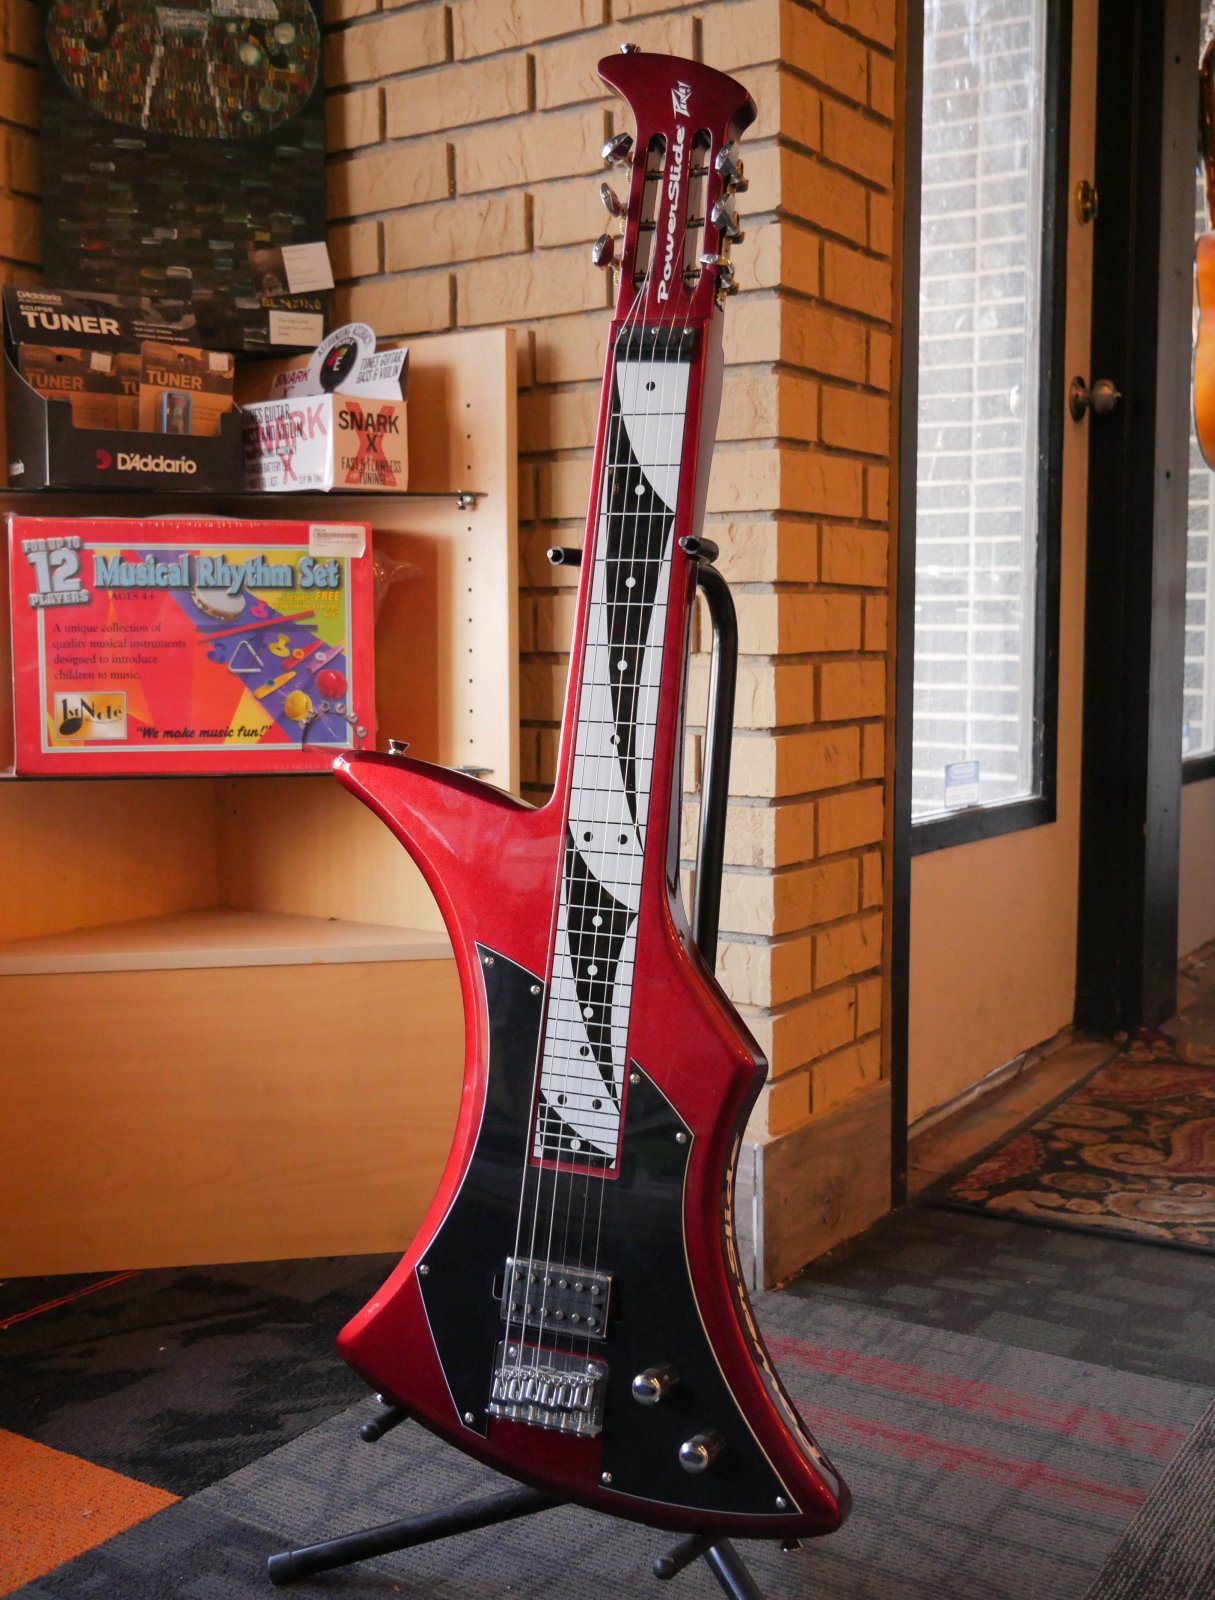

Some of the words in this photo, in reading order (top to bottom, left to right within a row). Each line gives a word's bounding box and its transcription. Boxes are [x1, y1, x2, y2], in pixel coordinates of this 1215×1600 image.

[657, 125, 686, 303] PowerSlide
[21, 311, 121, 336] TUNER
[25, 373, 84, 391] TUNER
[147, 370, 203, 390] TUNER
[264, 404, 290, 423] GUITAR
[338, 410, 400, 434] SNARK
[366, 433, 378, 453] X
[117, 453, 197, 474] D'Addario
[341, 457, 359, 471] FAST
[367, 458, 402, 474] FLAWLESS
[21, 539, 46, 553] FOR
[47, 537, 63, 550] UP
[63, 535, 82, 549] TO
[27, 548, 82, 594] 12
[93, 553, 191, 589] Musical
[196, 553, 294, 596] Rhythm
[299, 556, 341, 589] Set
[28, 590, 90, 607] PLAYERS
[315, 591, 340, 601] FREE
[52, 623, 61, 633] A
[64, 623, 98, 635] unique
[101, 622, 149, 633] collection
[151, 622, 162, 633] of
[53, 638, 86, 650] quality
[90, 638, 127, 649] musical
[129, 639, 187, 649] instruments
[53, 654, 97, 665] designed
[99, 655, 109, 664] to
[112, 654, 159, 664] introduce
[54, 669, 95, 680] children
[97, 671, 107, 680] to
[110, 670, 142, 680] music.
[80, 698, 123, 721] Note
[162, 726, 195, 739] make
[199, 725, 234, 739] music
